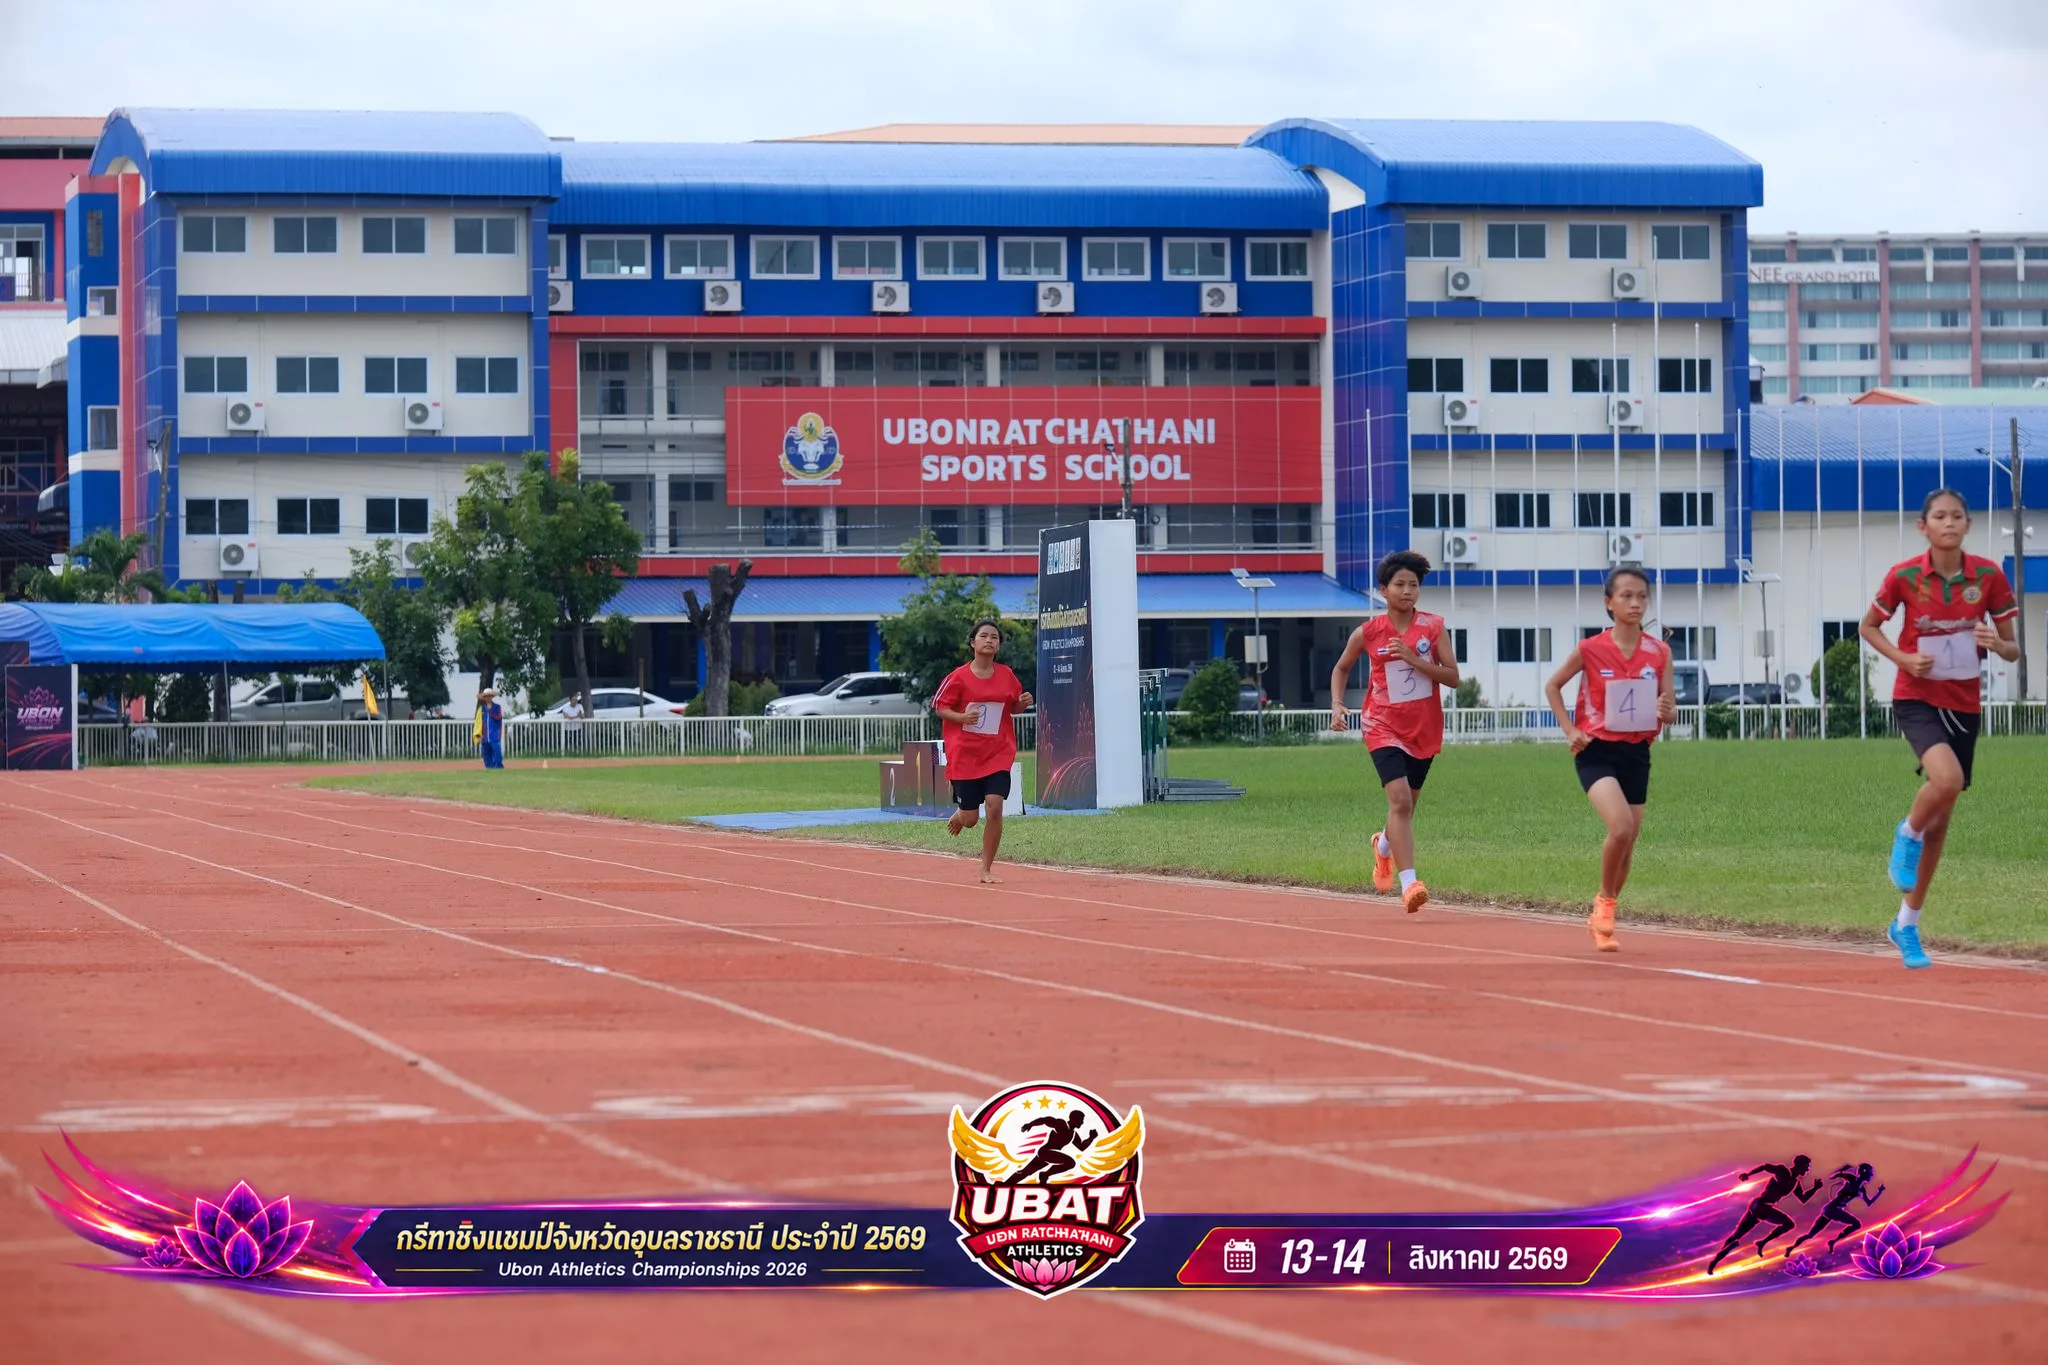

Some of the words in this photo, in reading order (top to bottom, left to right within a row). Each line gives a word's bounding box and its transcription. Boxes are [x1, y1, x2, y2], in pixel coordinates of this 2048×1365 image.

[1785, 271, 1834, 282] GRAND
[1838, 271, 1877, 282] HOTEL
[883, 417, 1216, 446] UBONRATCHATHANI
[922, 453, 1047, 482] SPORTS
[1065, 453, 1190, 483] SCHOOL
[1398, 668, 1416, 696] 3
[16, 706, 64, 719] UBON
[1618, 687, 1637, 722] 4
[889, 767, 896, 807] 2
[915, 751, 923, 806] 1
